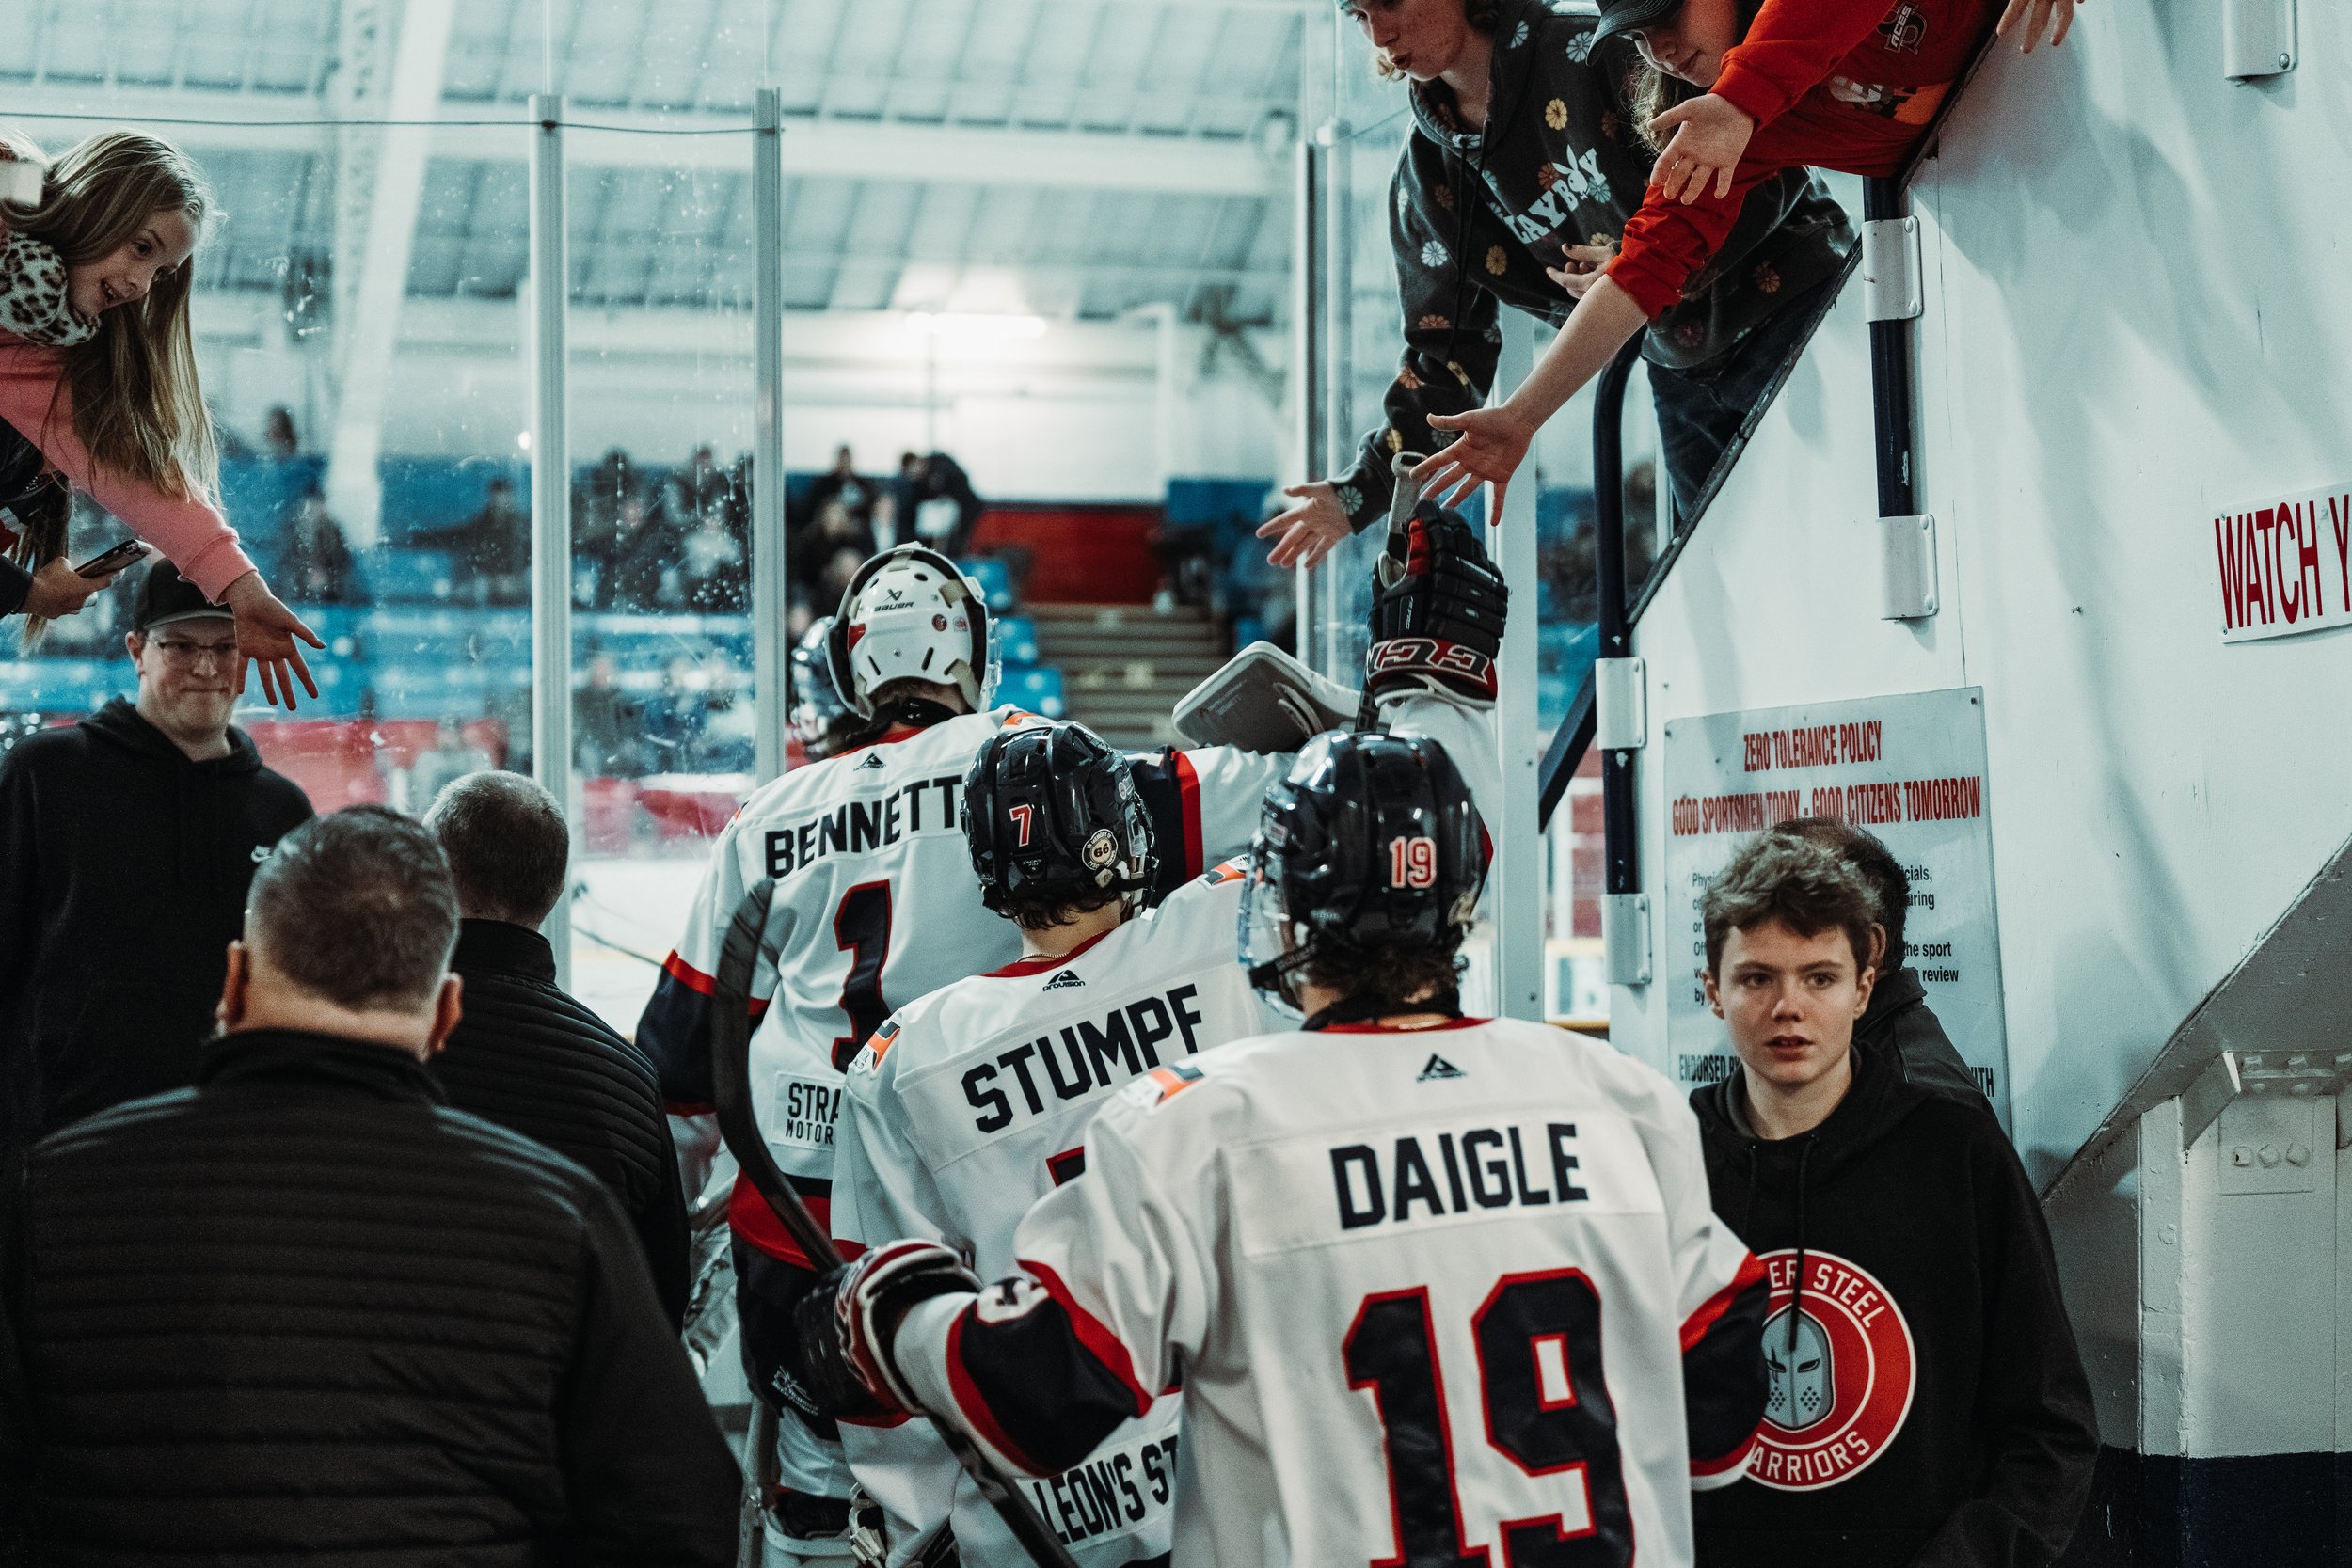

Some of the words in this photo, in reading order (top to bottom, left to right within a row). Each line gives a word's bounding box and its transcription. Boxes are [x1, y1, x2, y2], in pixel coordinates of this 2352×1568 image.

[1891, 5, 1913, 48] ACES
[2215, 501, 2323, 629] WATCH
[874, 602, 914, 611] BAUER
[1744, 731, 1771, 772] ZERO
[1772, 724, 1837, 769] TOLERANCE
[1840, 720, 1882, 764] POLICY
[765, 774, 962, 879] BENNETT
[1009, 803, 1033, 847] 7
[1673, 798, 1699, 836] GOOD
[1702, 793, 1764, 834] SPORTSMEN
[1766, 790, 1800, 830] TODAY
[1812, 786, 1844, 823] GOOD
[1847, 782, 1901, 825] CITIZENS
[1904, 776, 1980, 821] TOMORROW
[1093, 843, 1109, 858] 66
[1389, 836, 1437, 888] 19
[831, 879, 893, 1074] 1
[1922, 942, 1951, 960] sport
[1922, 966, 1959, 982] review
[1042, 980, 1086, 992] provision
[1694, 988, 1705, 1006] by
[961, 983, 1202, 1133] STUMPF
[1678, 1054, 1725, 1082] ENDORSED
[786, 1118, 833, 1145] MOTOR
[1330, 1123, 1589, 1230] DAIGLE
[1813, 1263, 1885, 1328] STEEL
[1342, 1266, 1635, 1568] 19
[1033, 1452, 1146, 1544] LEON'S
